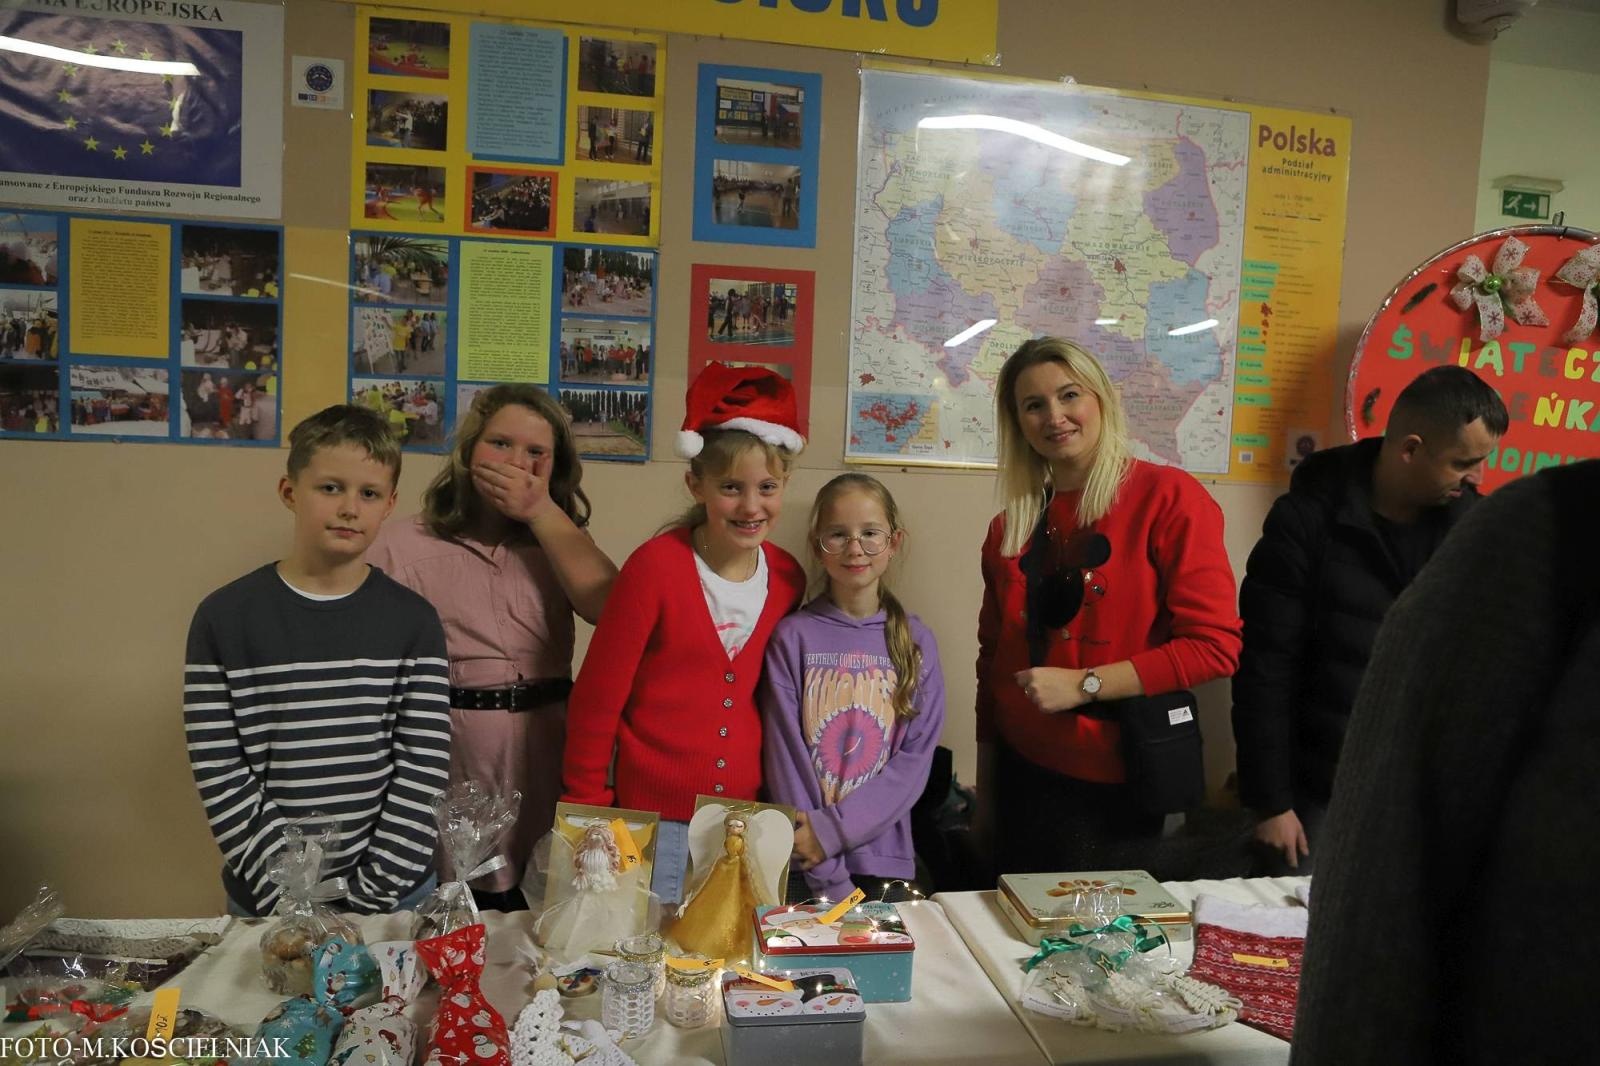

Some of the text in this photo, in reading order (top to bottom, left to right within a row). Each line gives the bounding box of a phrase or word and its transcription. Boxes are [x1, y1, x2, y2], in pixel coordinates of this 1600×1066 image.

[1258, 124, 1336, 157] Polska
[1262, 166, 1332, 182] administracyjny
[53, 181, 116, 195] Europejskiego
[118, 186, 161, 197] Funduszu
[163, 188, 201, 200] Rozwoju
[203, 191, 261, 204] Regionalnego
[68, 195, 88, 203] oraz
[135, 199, 171, 208] państwa
